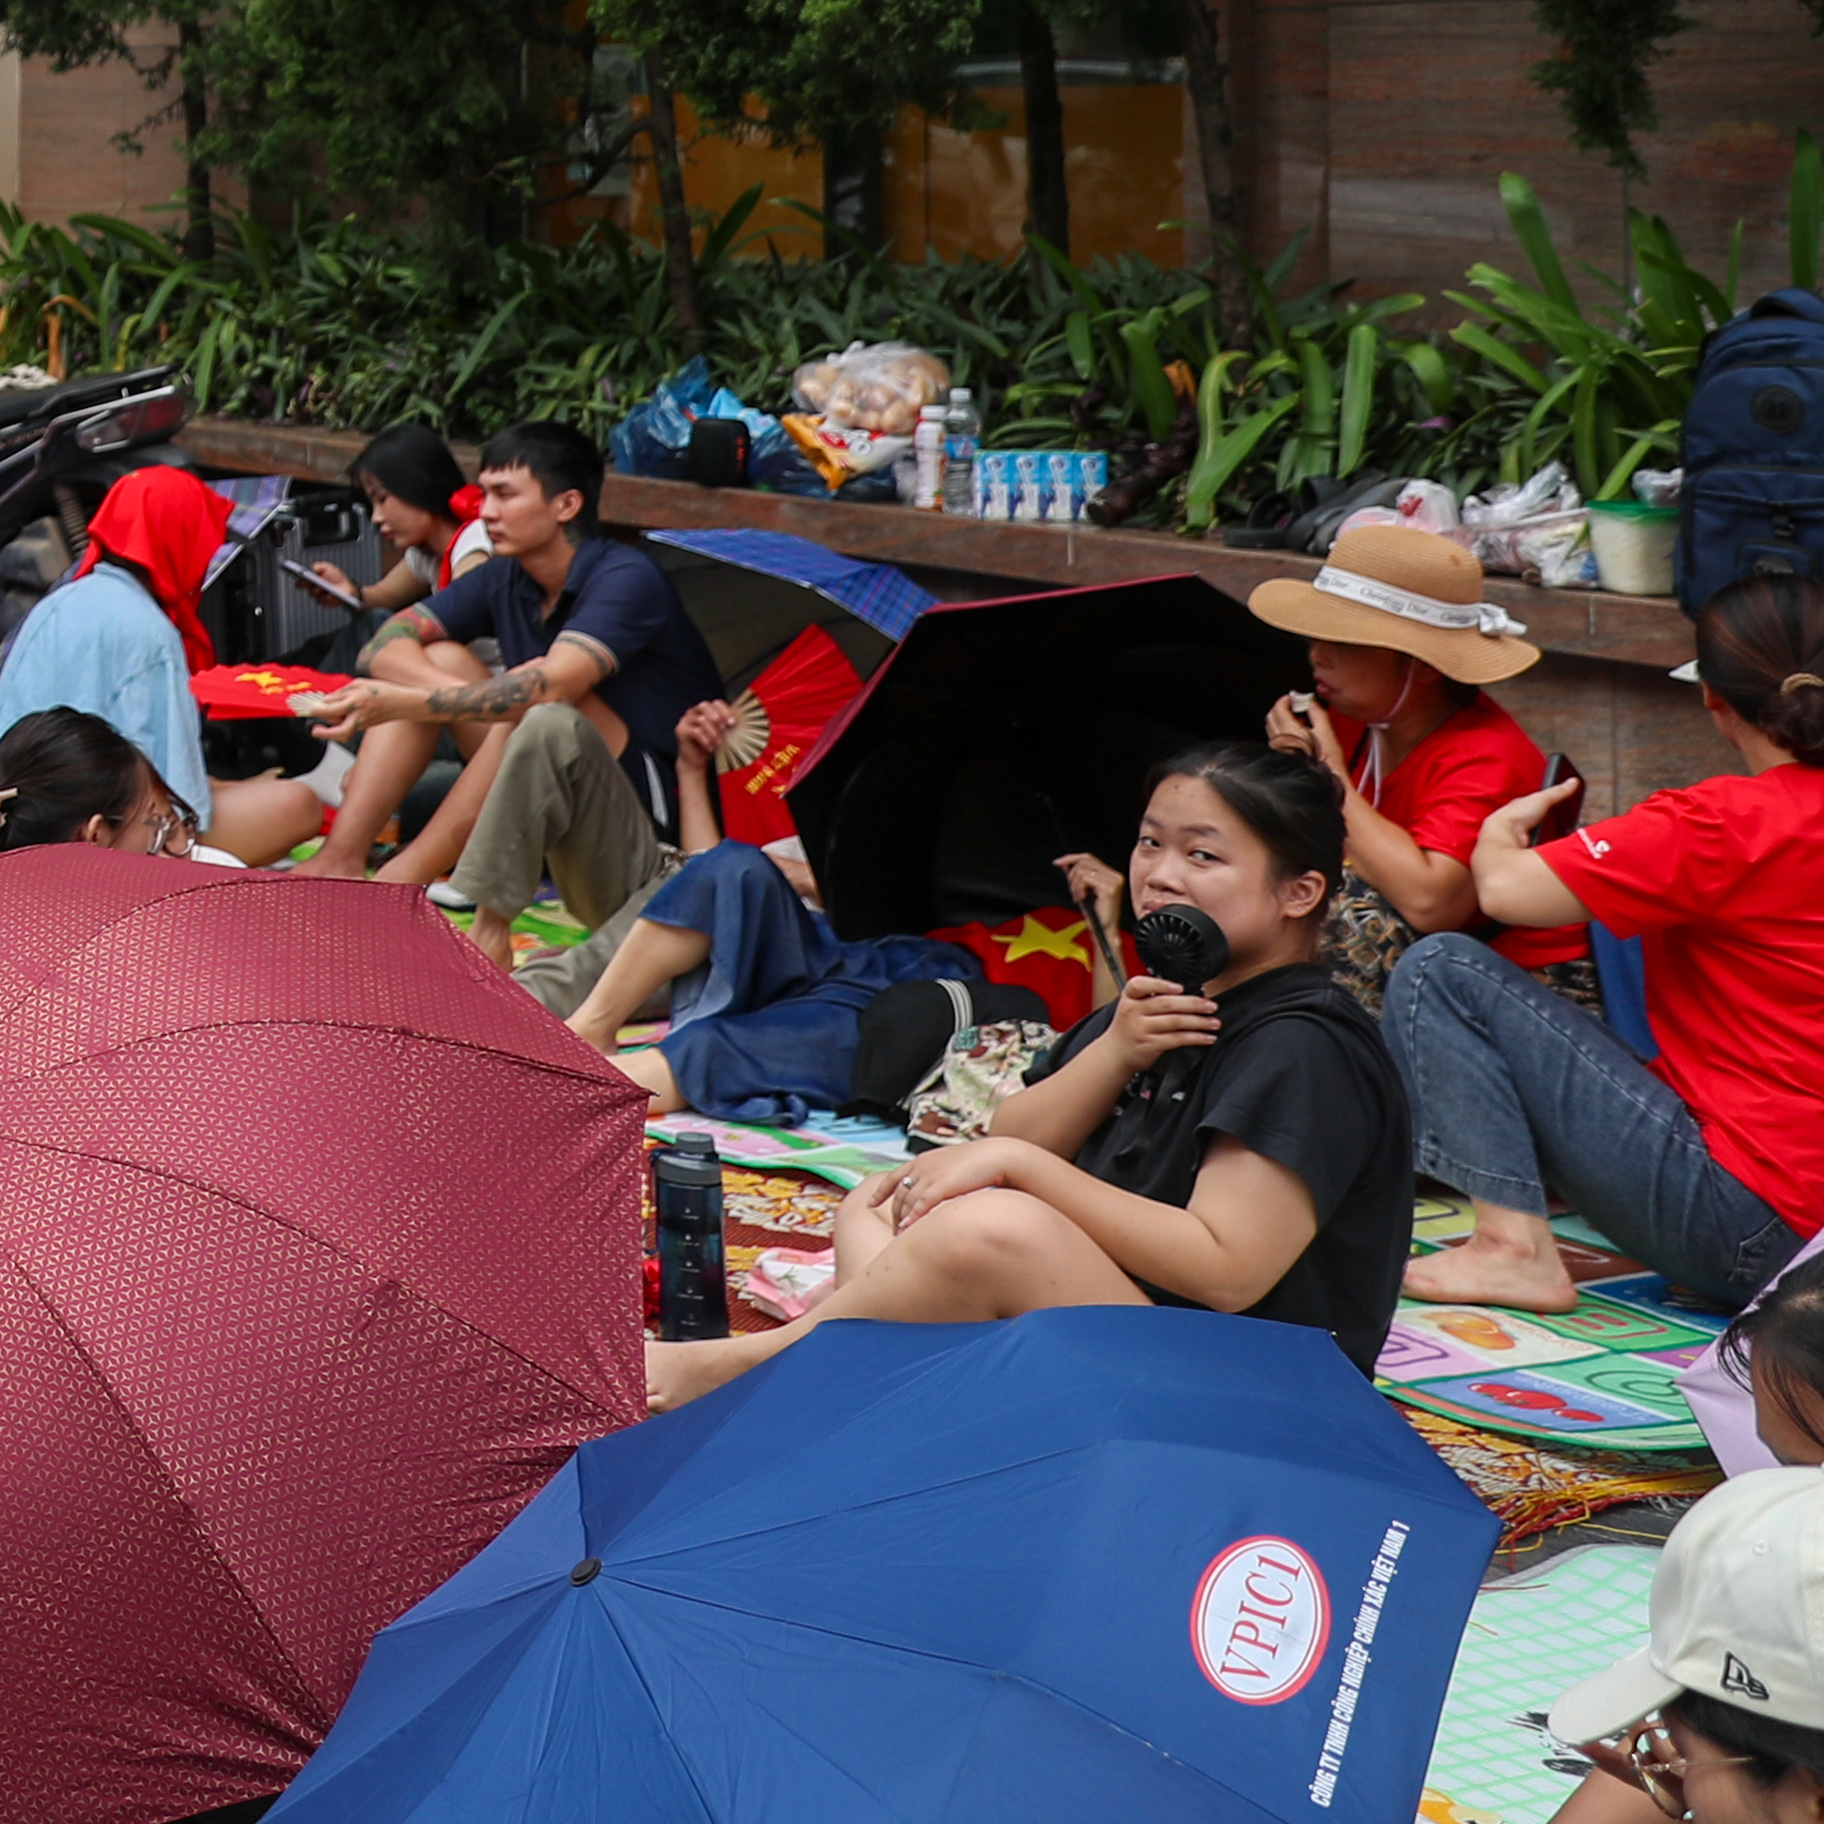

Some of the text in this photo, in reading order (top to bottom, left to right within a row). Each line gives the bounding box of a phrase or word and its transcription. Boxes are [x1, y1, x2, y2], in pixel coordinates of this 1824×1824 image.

[1218, 1553, 1304, 1680] VPIC1
[1309, 1519, 1411, 1808] CÔNG TY TNHH CÔNG NGHIỆP CHÍNH XÁC VIỆT NAM 1
